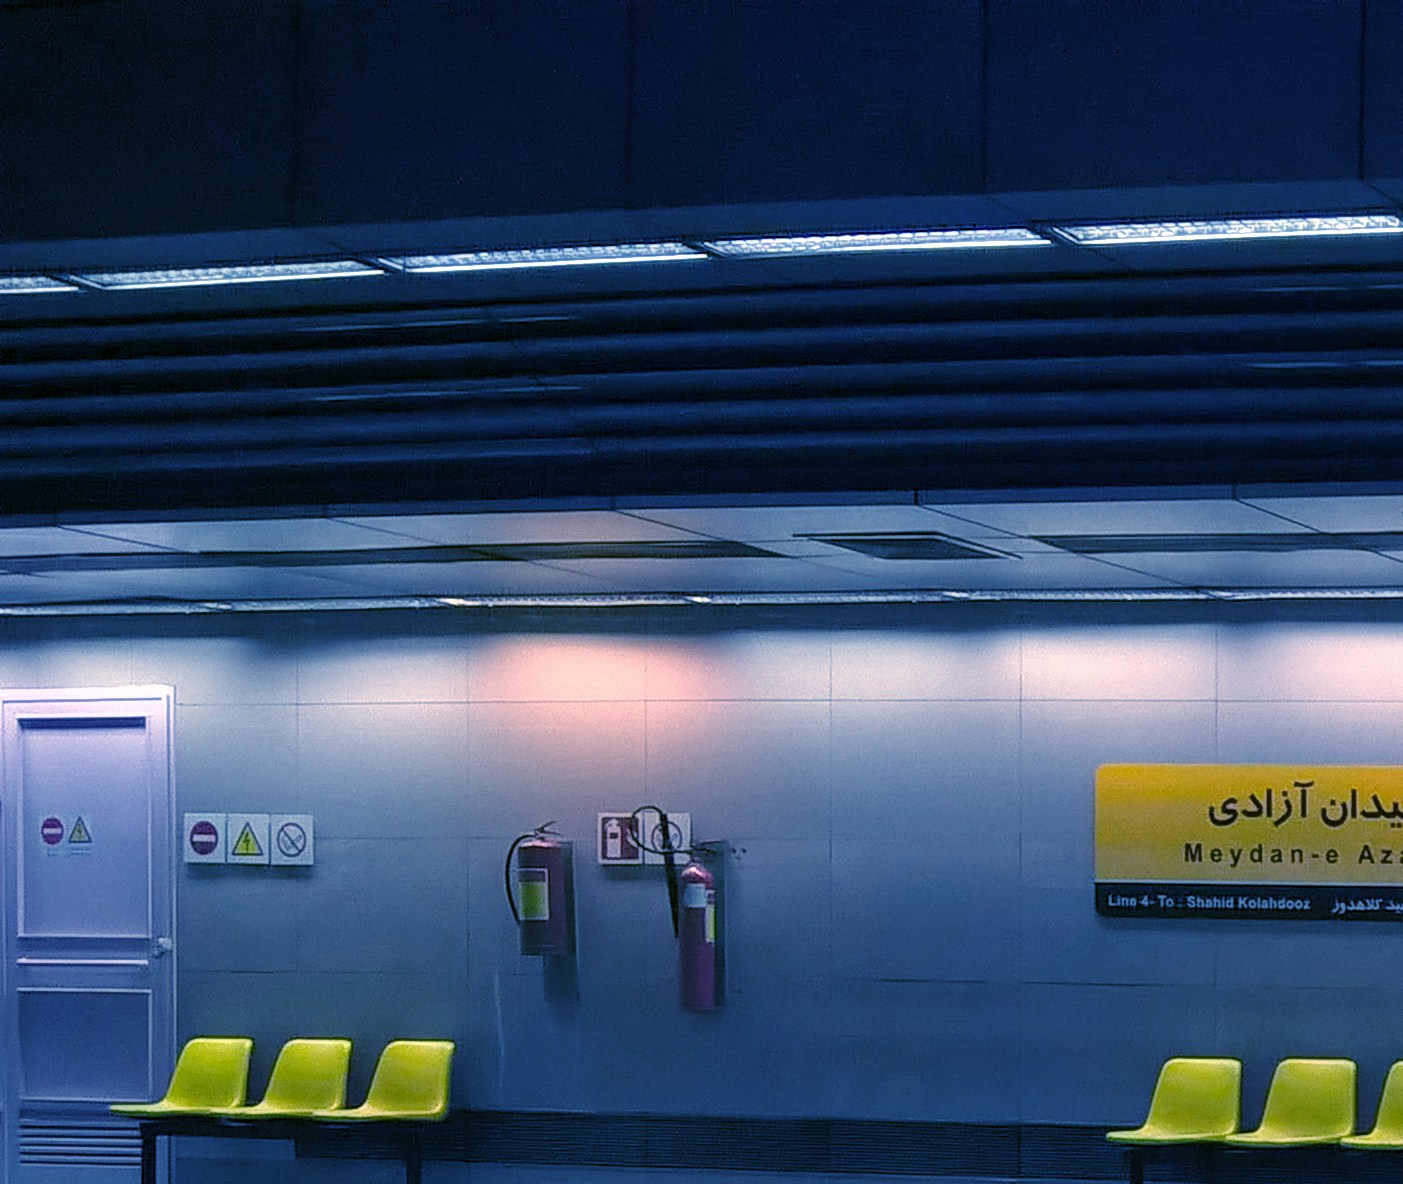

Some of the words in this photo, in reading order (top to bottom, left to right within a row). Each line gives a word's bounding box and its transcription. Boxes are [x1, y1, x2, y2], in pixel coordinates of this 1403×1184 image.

[1208, 780, 1315, 827] آزادی
[1184, 842, 1340, 868] Meydan-e
[1107, 894, 1138, 907] Line
[1157, 894, 1175, 908] To
[1186, 895, 1235, 910] Shahid
[1237, 896, 1312, 910] Kolahdooz
